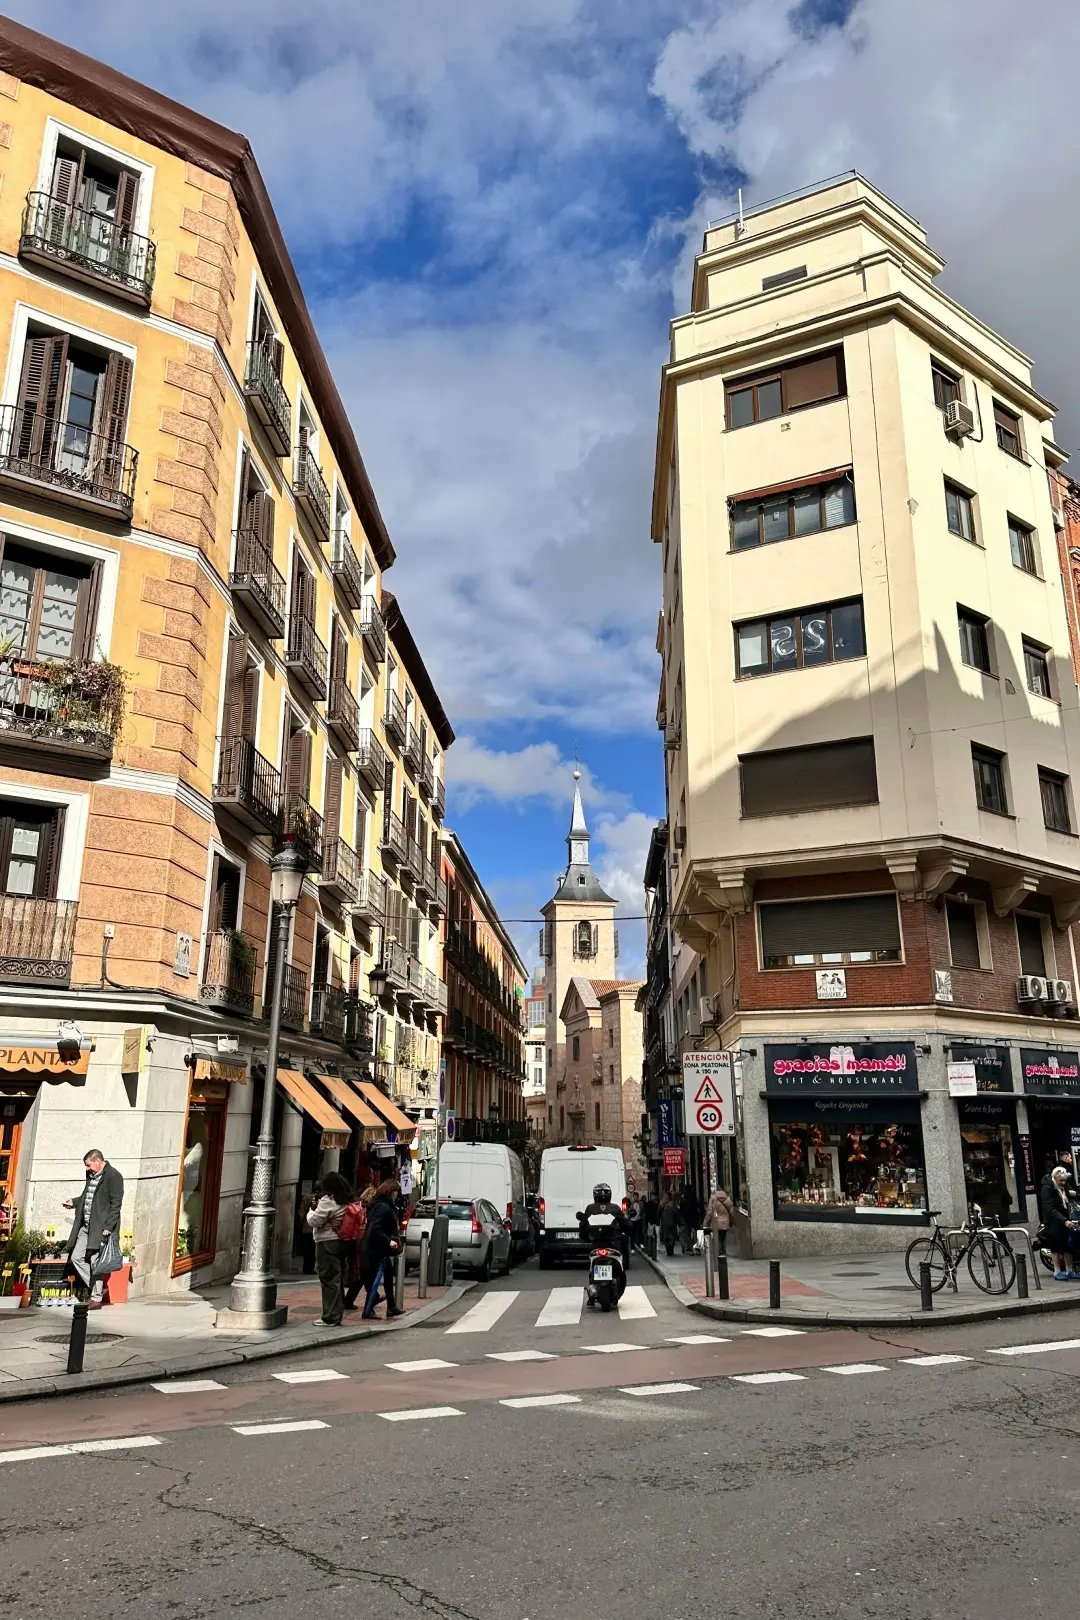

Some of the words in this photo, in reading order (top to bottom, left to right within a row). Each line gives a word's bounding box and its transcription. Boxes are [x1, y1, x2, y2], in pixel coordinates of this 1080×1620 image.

[685, 1053, 728, 1061] ATENCIÓN
[774, 1055, 841, 1075] gracias
[846, 1053, 907, 1073] mamá!!
[812, 1075, 822, 1084] &
[702, 1113, 717, 1121] 20
